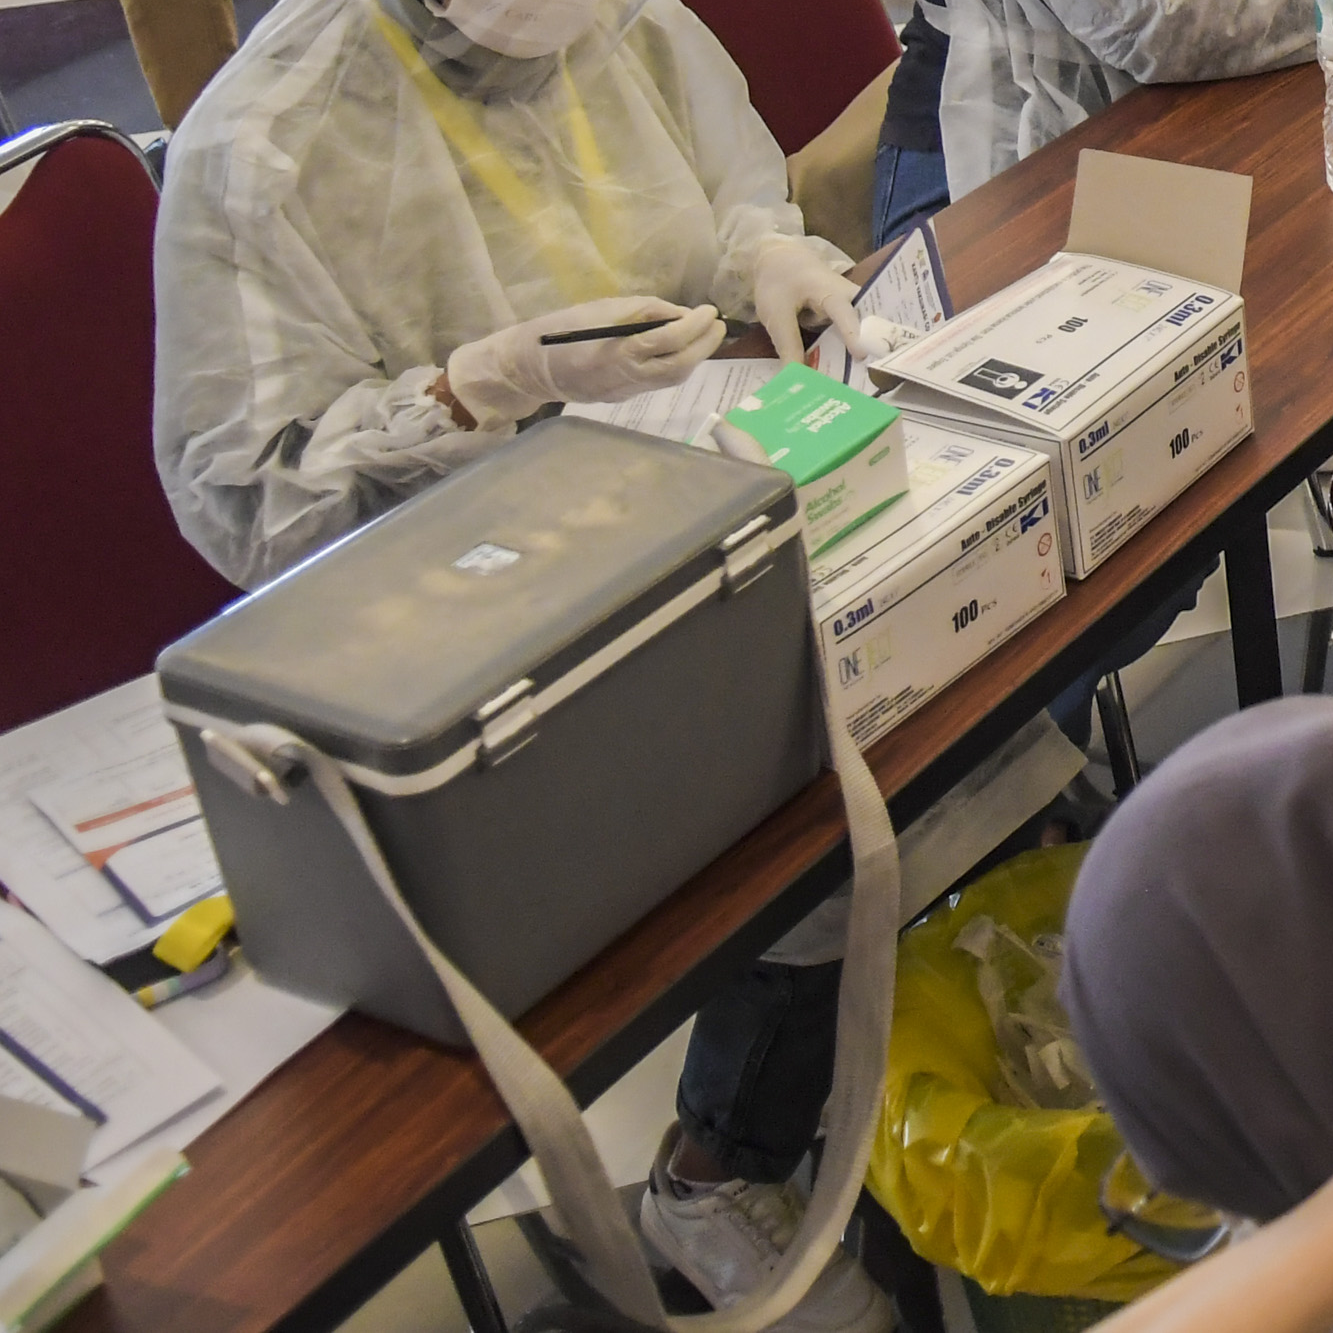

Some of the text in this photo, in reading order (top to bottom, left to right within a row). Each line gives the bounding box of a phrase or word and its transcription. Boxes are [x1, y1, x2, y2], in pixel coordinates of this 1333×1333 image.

[1058, 316, 1089, 333] 100
[1165, 294, 1215, 327] 0.3ml
[1174, 364, 1190, 382] Auto
[1193, 343, 1218, 366] Disable
[1218, 321, 1241, 346] Syringe
[806, 401, 851, 433] Alcohol
[1078, 421, 1109, 454] 0.3ml
[1169, 428, 1190, 459] 100
[956, 458, 1015, 496] 0.3ml
[960, 530, 980, 552] Auto
[985, 503, 1017, 532] Disable
[1017, 479, 1047, 508] Syringe
[833, 598, 874, 636] 0.3ml
[952, 599, 979, 633] 100
